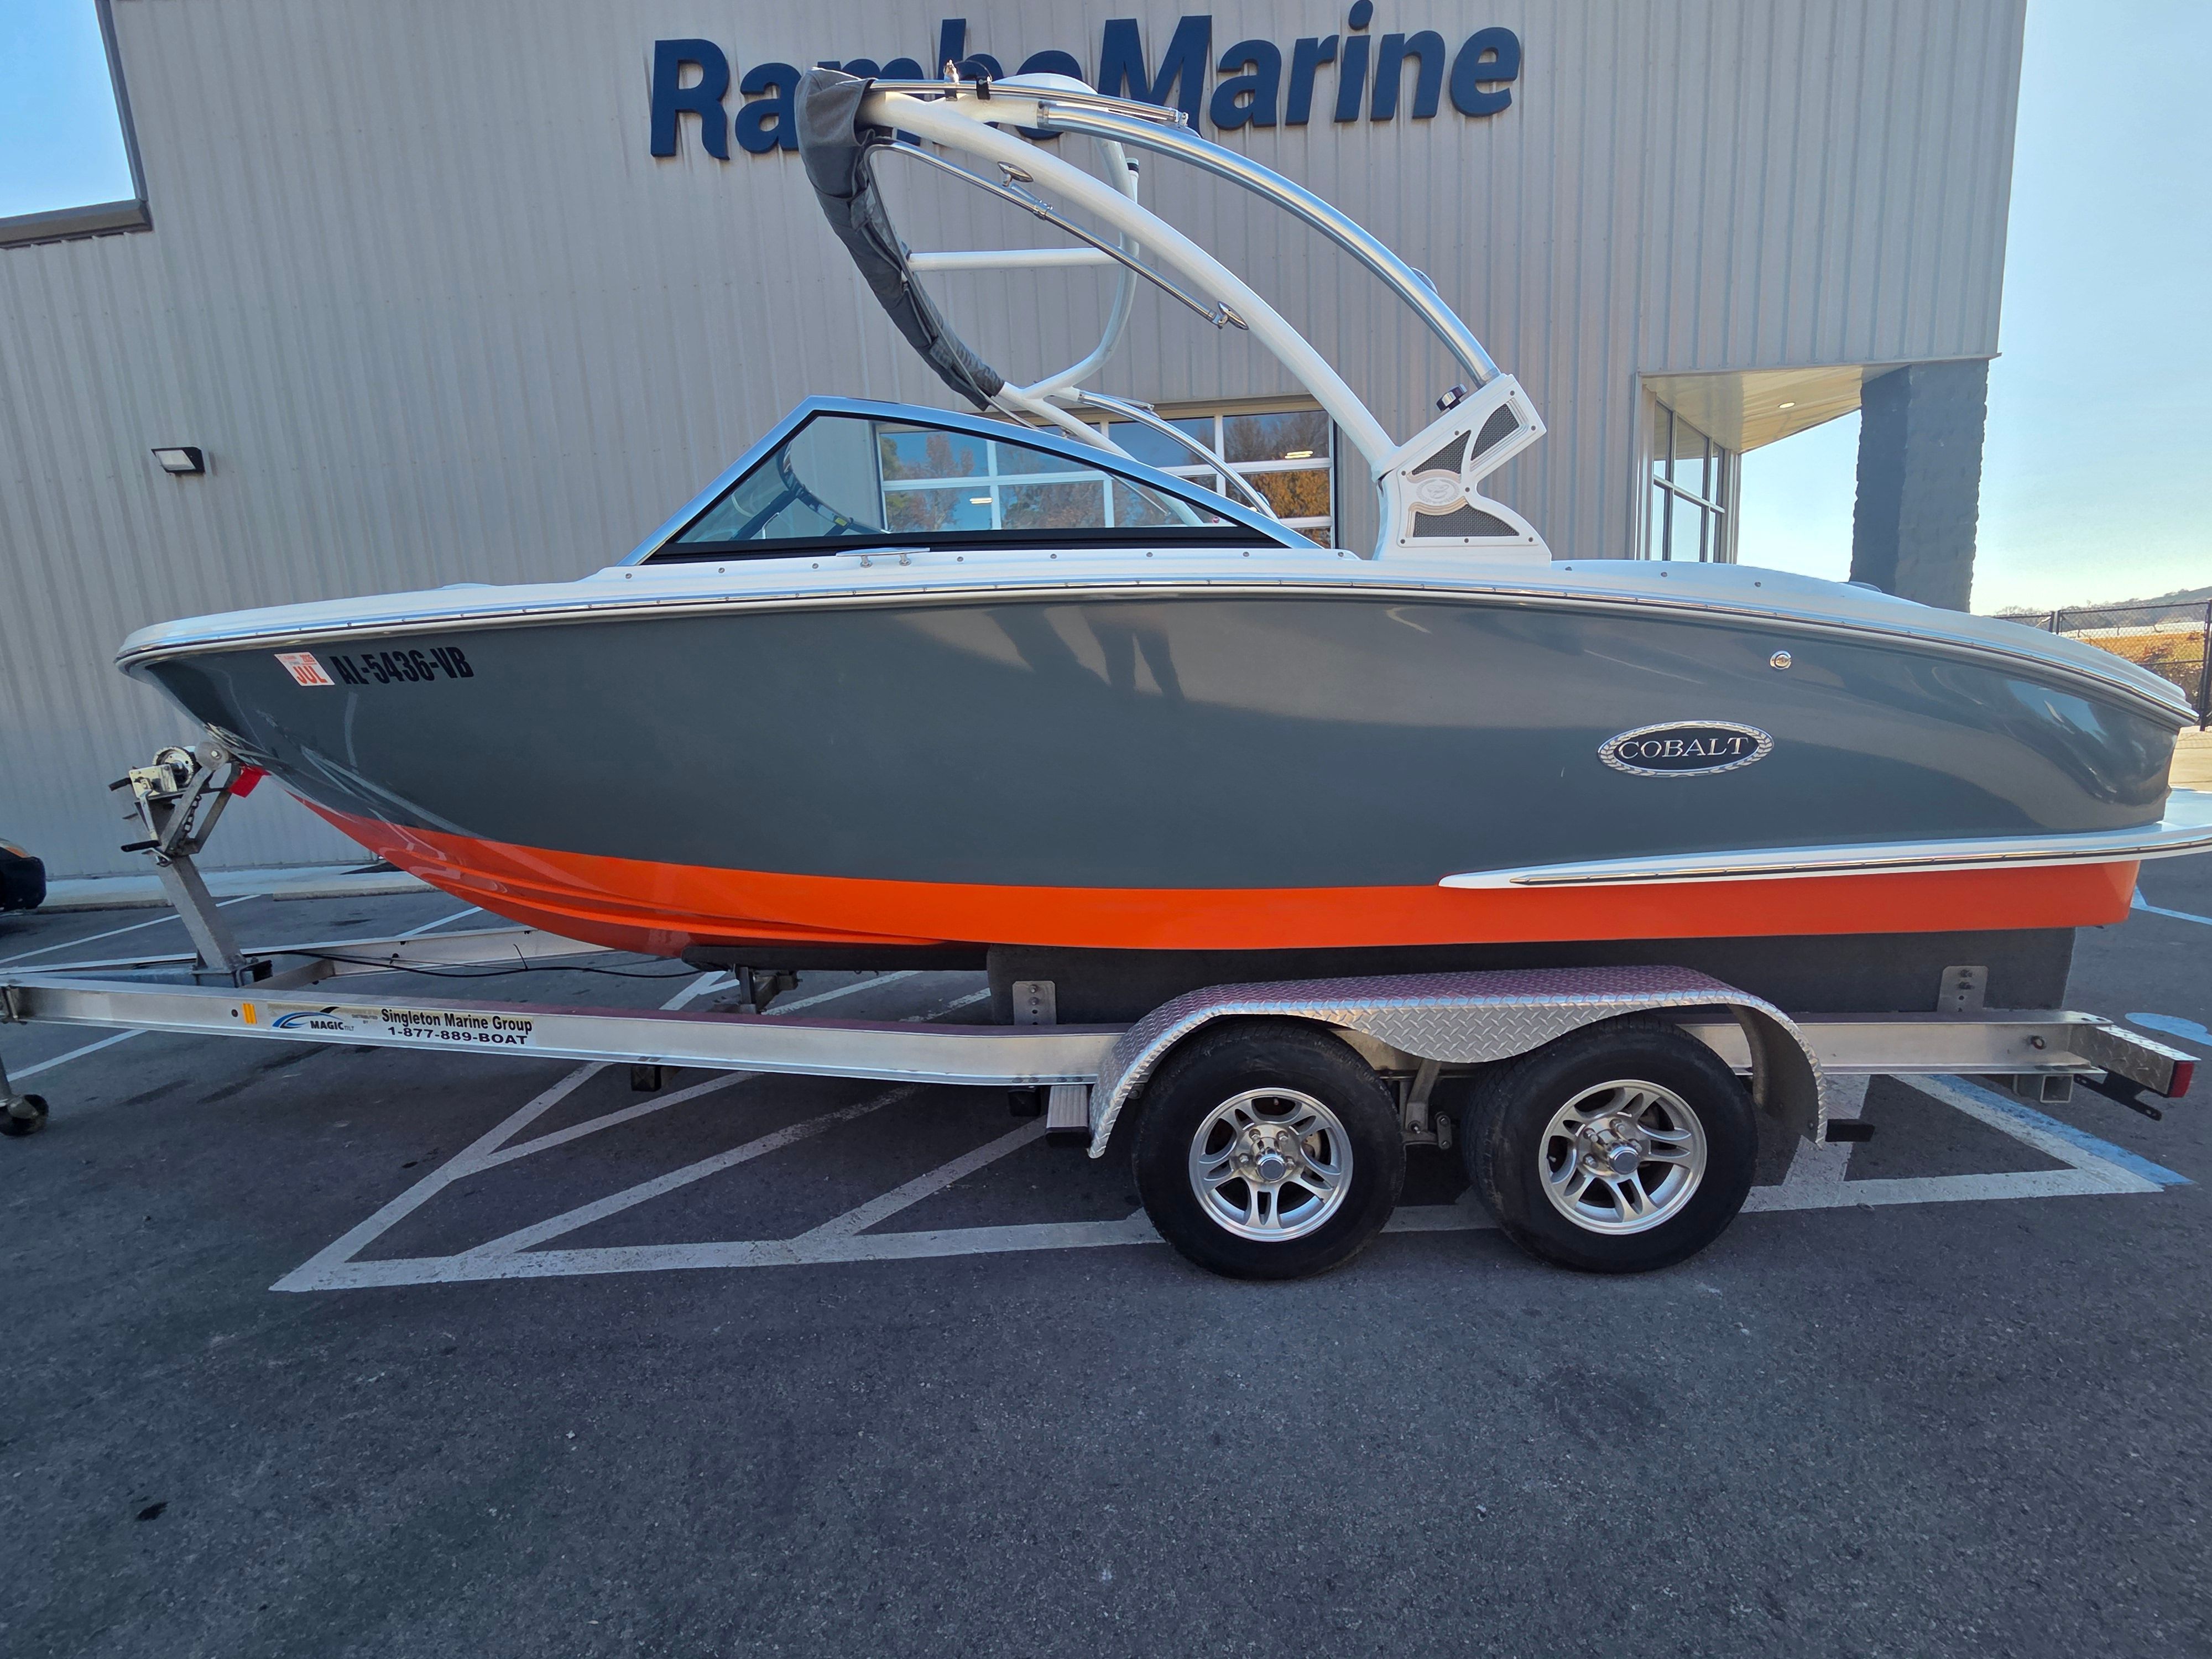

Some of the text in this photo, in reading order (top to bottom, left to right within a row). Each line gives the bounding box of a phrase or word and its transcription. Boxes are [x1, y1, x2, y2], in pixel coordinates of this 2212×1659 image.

[293, 665, 328, 684] JUL
[330, 646, 474, 685] AL-5436-VB
[1618, 737, 1749, 759] COBALT
[381, 1008, 532, 1035] Singleton Marine Group
[388, 1026, 528, 1044] 1-877-889-BOAT
